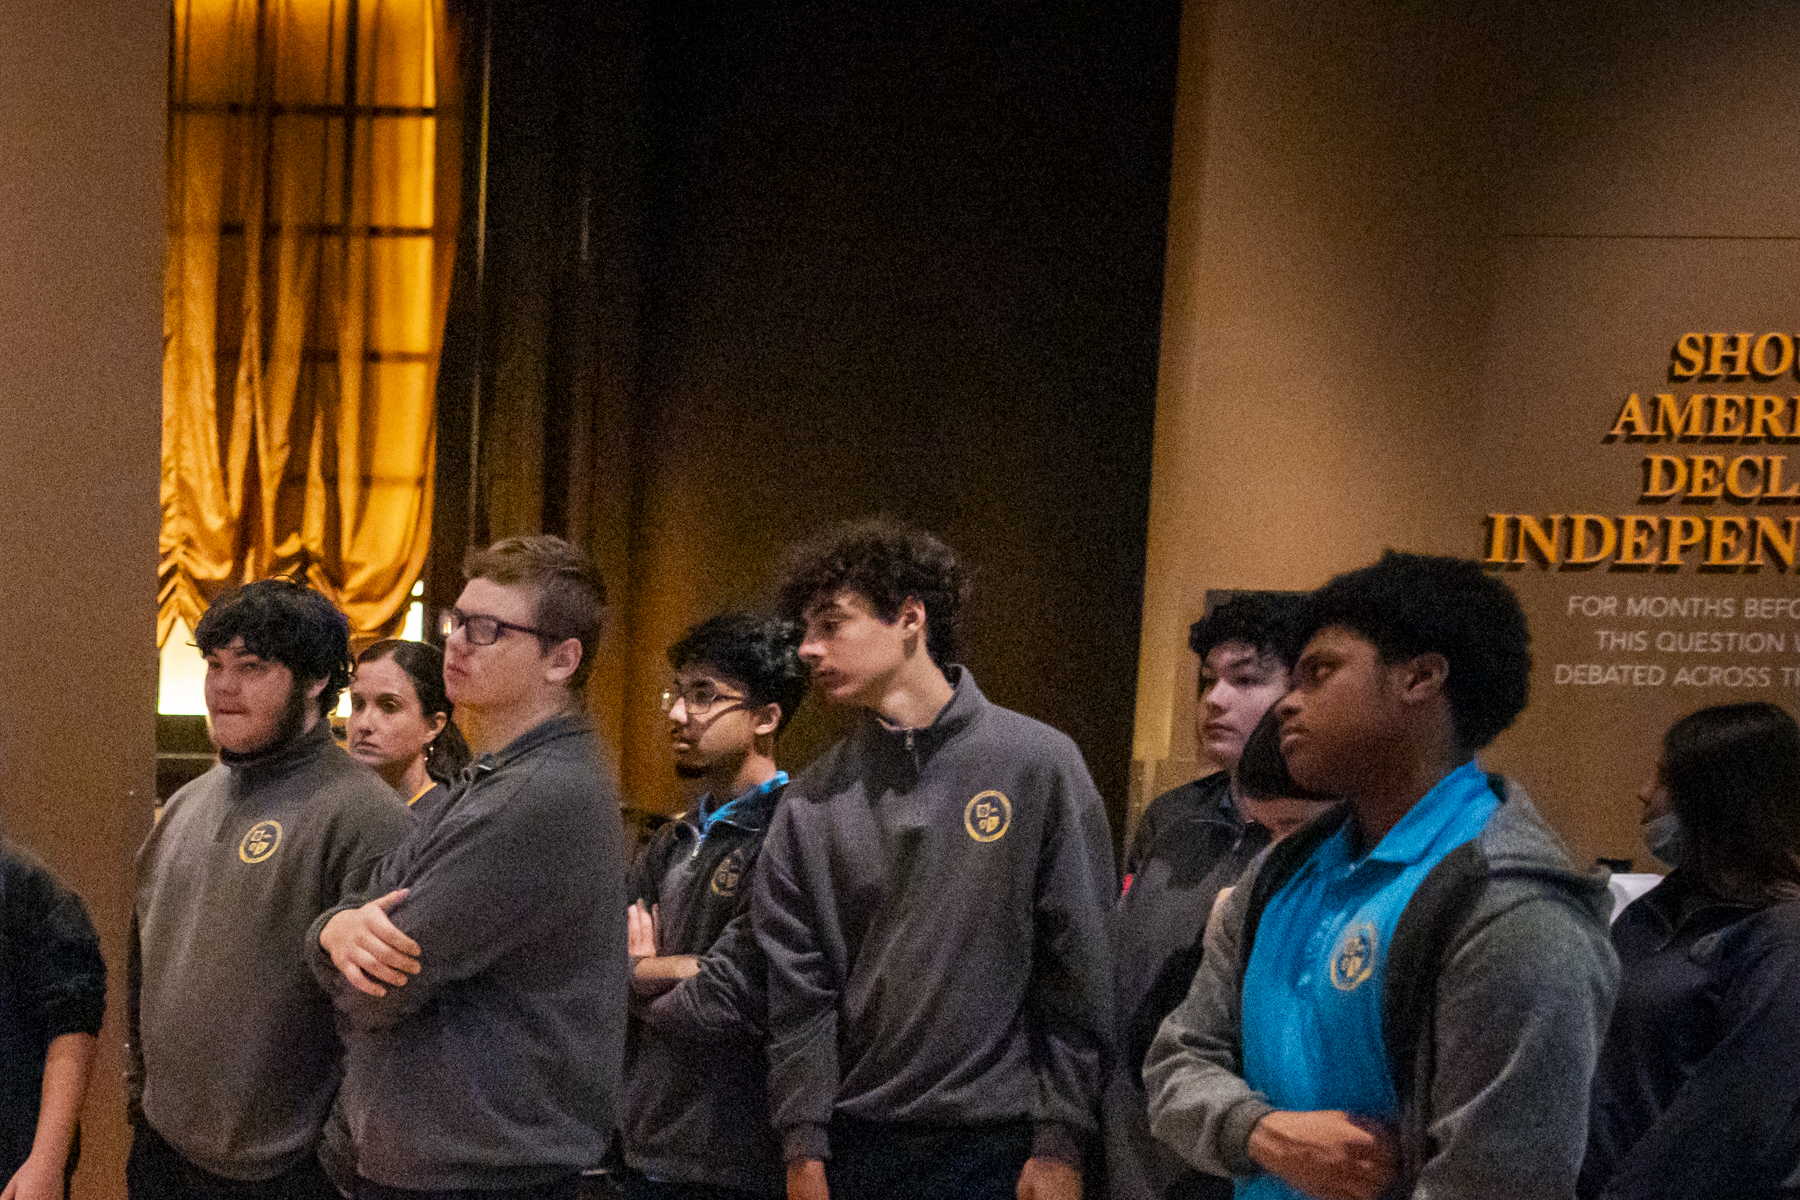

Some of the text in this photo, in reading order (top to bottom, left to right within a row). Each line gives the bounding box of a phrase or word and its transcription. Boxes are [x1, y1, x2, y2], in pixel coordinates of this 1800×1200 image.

[1675, 331, 1800, 376] SHO
[1568, 596, 1618, 616] FOR
[1627, 597, 1735, 618] MONTHS
[1596, 631, 1648, 651] THIS
[1656, 632, 1785, 653] QUESTION
[1555, 664, 1666, 685] DEBATED
[1674, 667, 1771, 687] ACROSS
